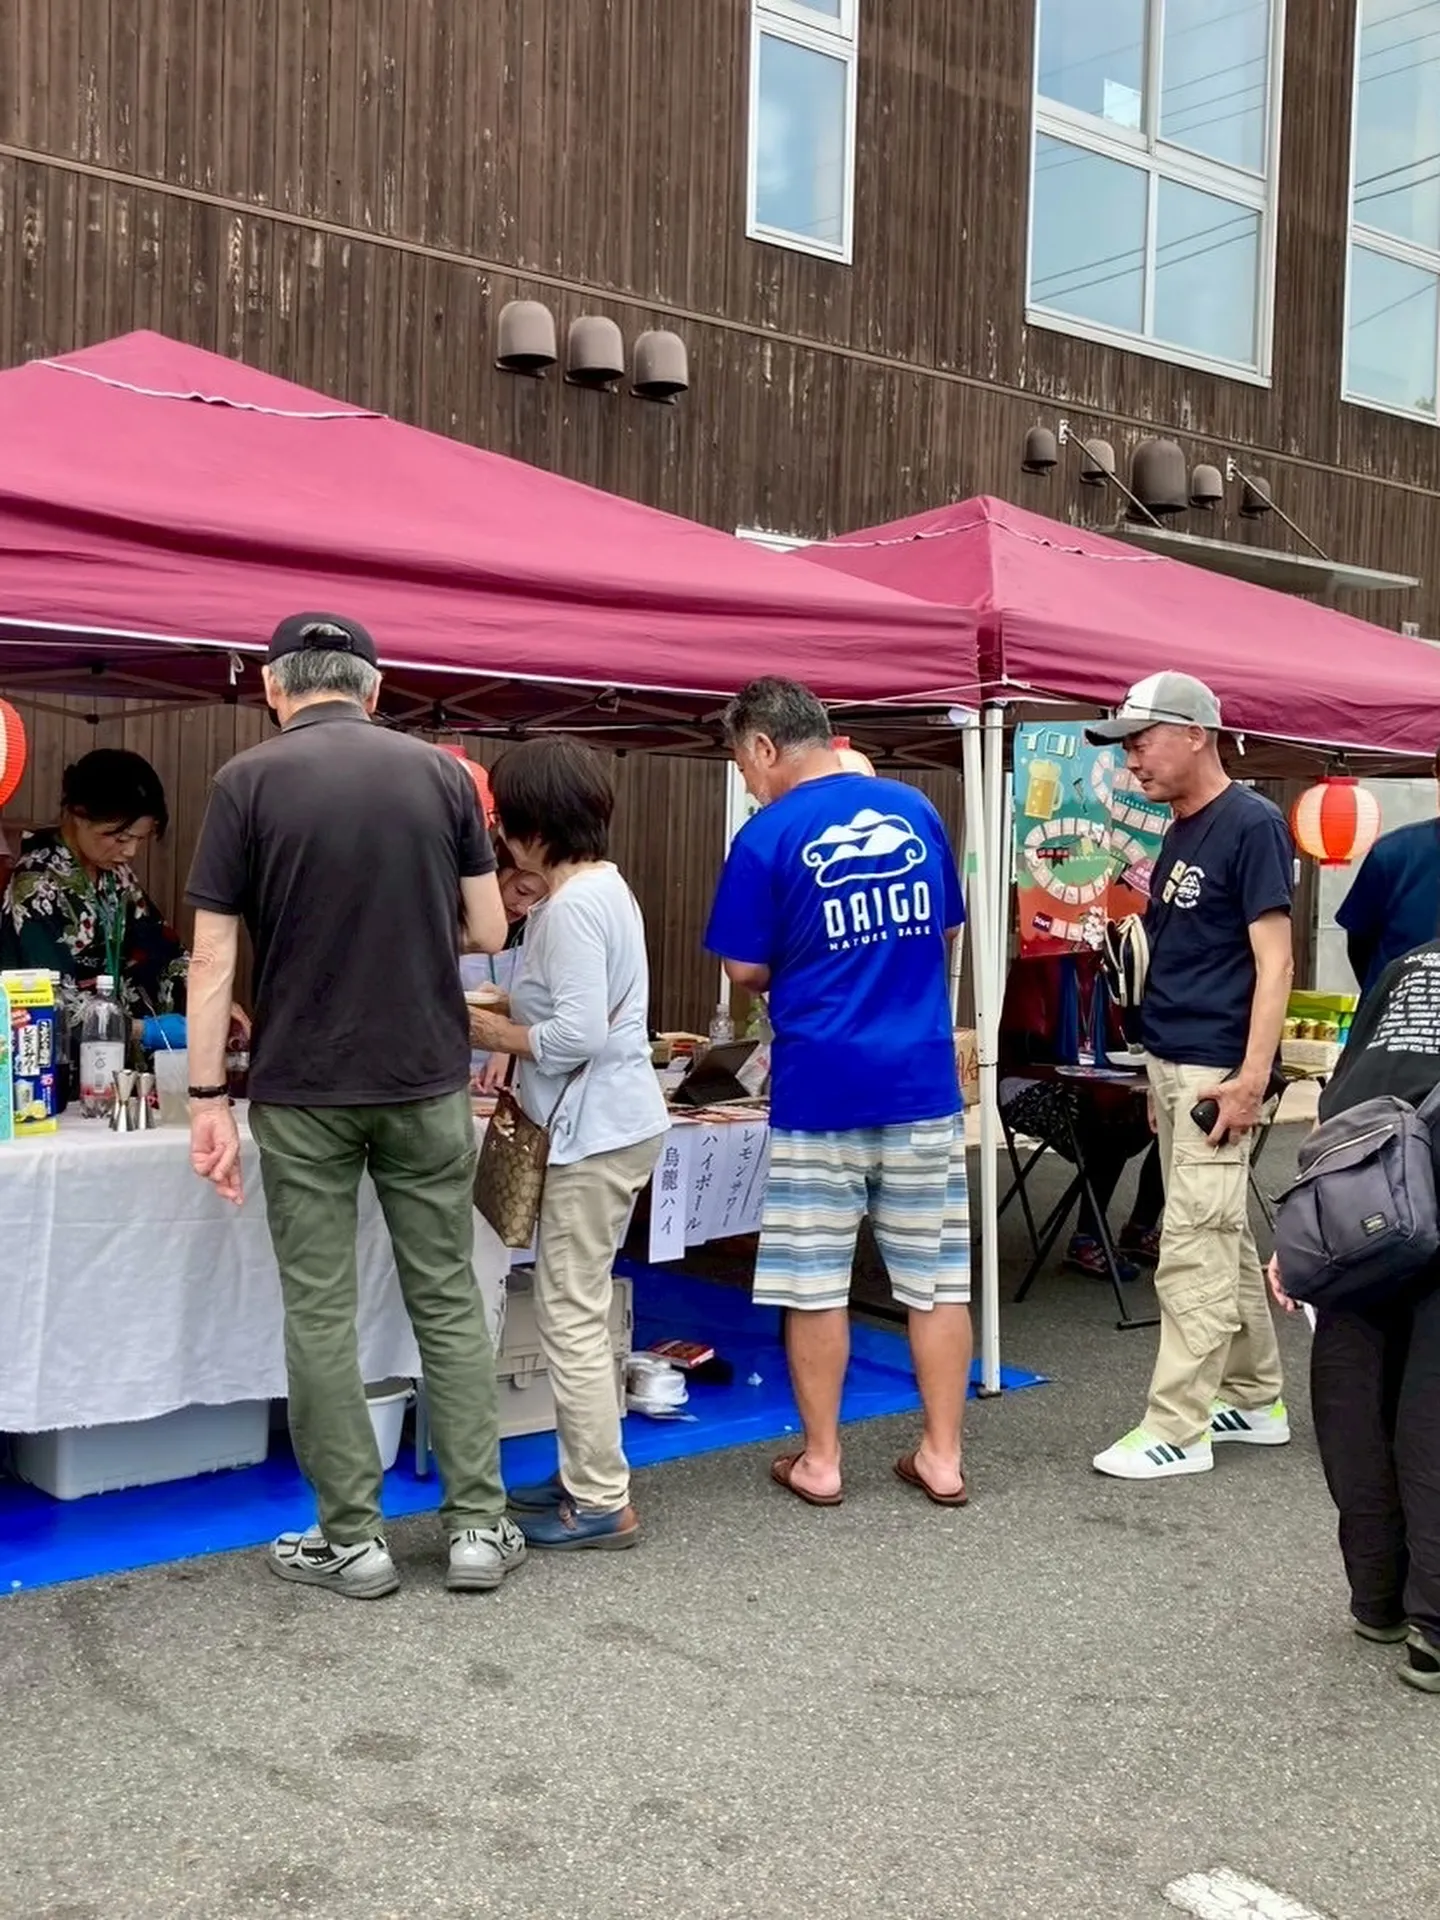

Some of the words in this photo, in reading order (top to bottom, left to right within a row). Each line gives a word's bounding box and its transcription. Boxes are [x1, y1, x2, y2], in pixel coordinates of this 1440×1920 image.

[823, 881, 931, 939] DAIGO
[829, 931, 888, 951] NATURE
[898, 925, 930, 937] BASE
[660, 1146, 680, 1235] 烏龍ハイ
[685, 1135, 718, 1230] ハイボール
[723, 1129, 756, 1228] レモンサワー
